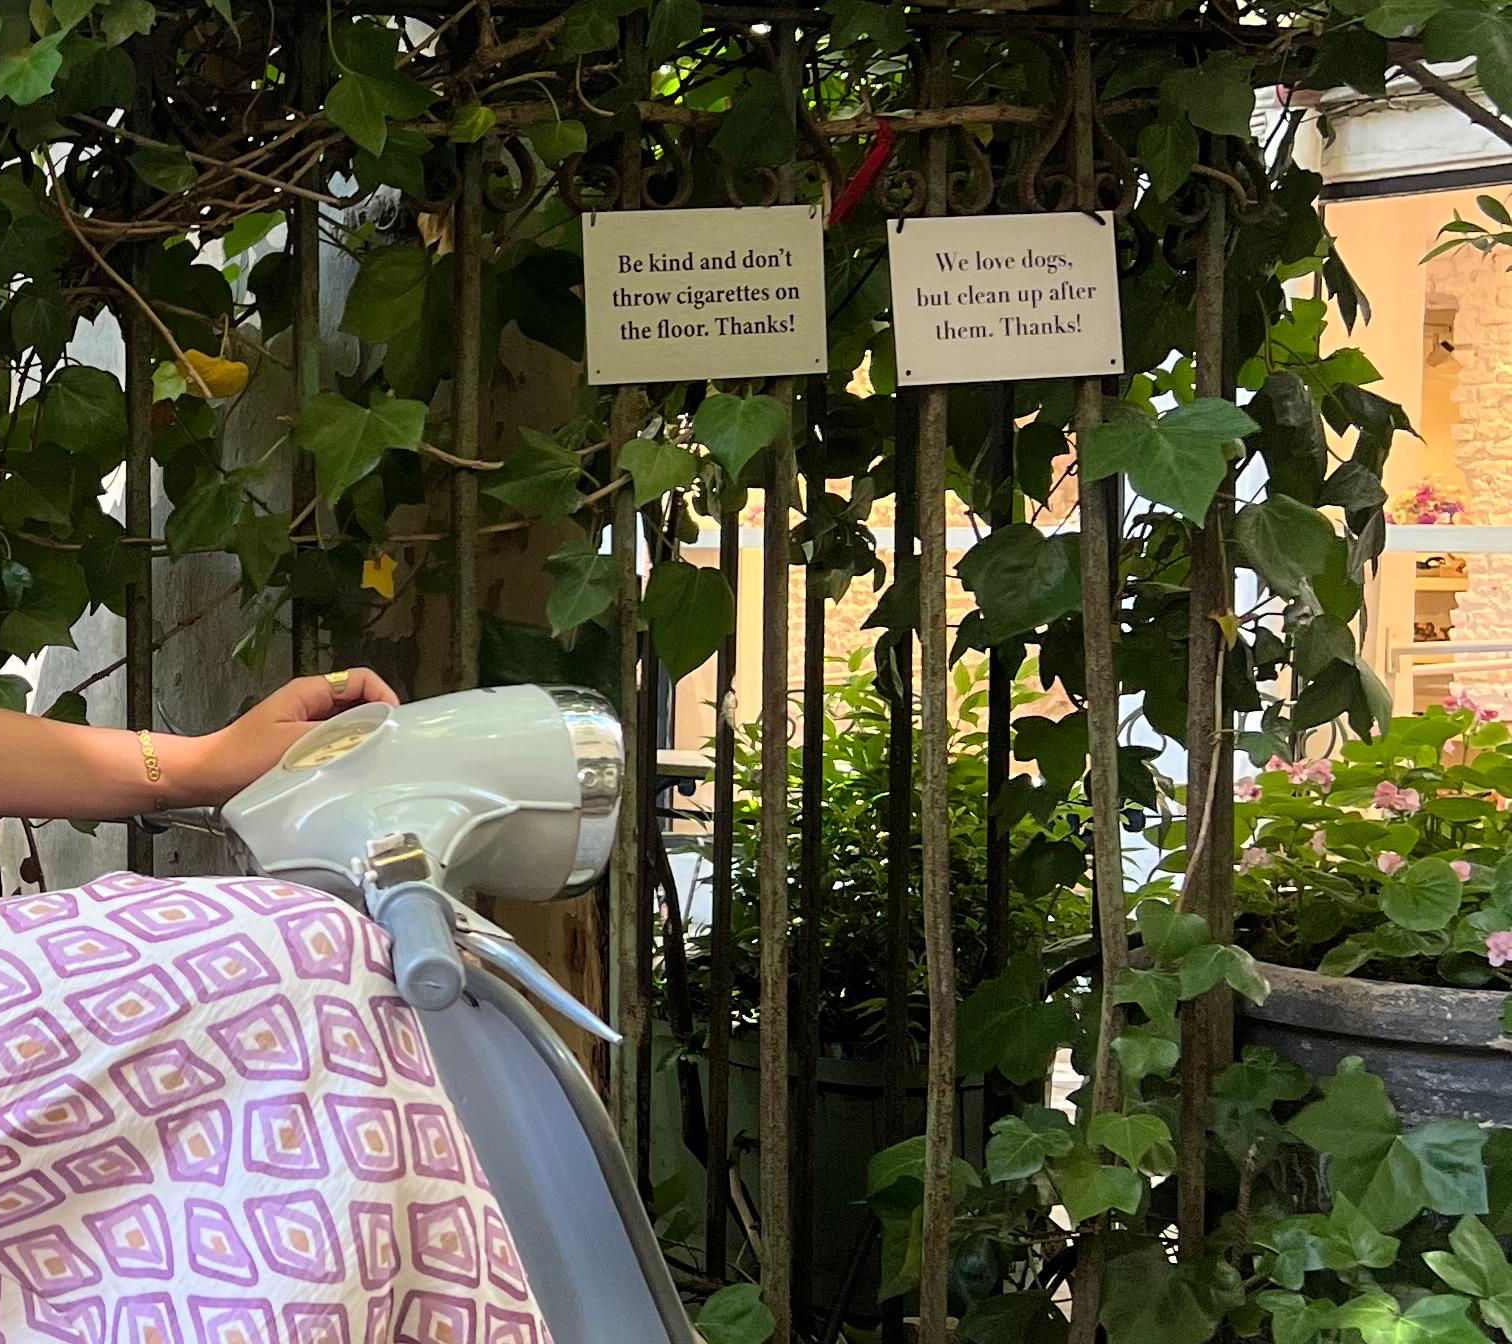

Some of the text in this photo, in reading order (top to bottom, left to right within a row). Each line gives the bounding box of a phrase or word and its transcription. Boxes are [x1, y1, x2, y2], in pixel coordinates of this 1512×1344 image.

[618, 248, 793, 274] Be kind and don't
[935, 248, 1073, 274] We love dogs,
[612, 284, 800, 310] throw cigarettes on
[917, 280, 1097, 309] but clean up after
[620, 313, 795, 340] the floor. Thanks!
[936, 313, 1082, 340] them. Thanks!
